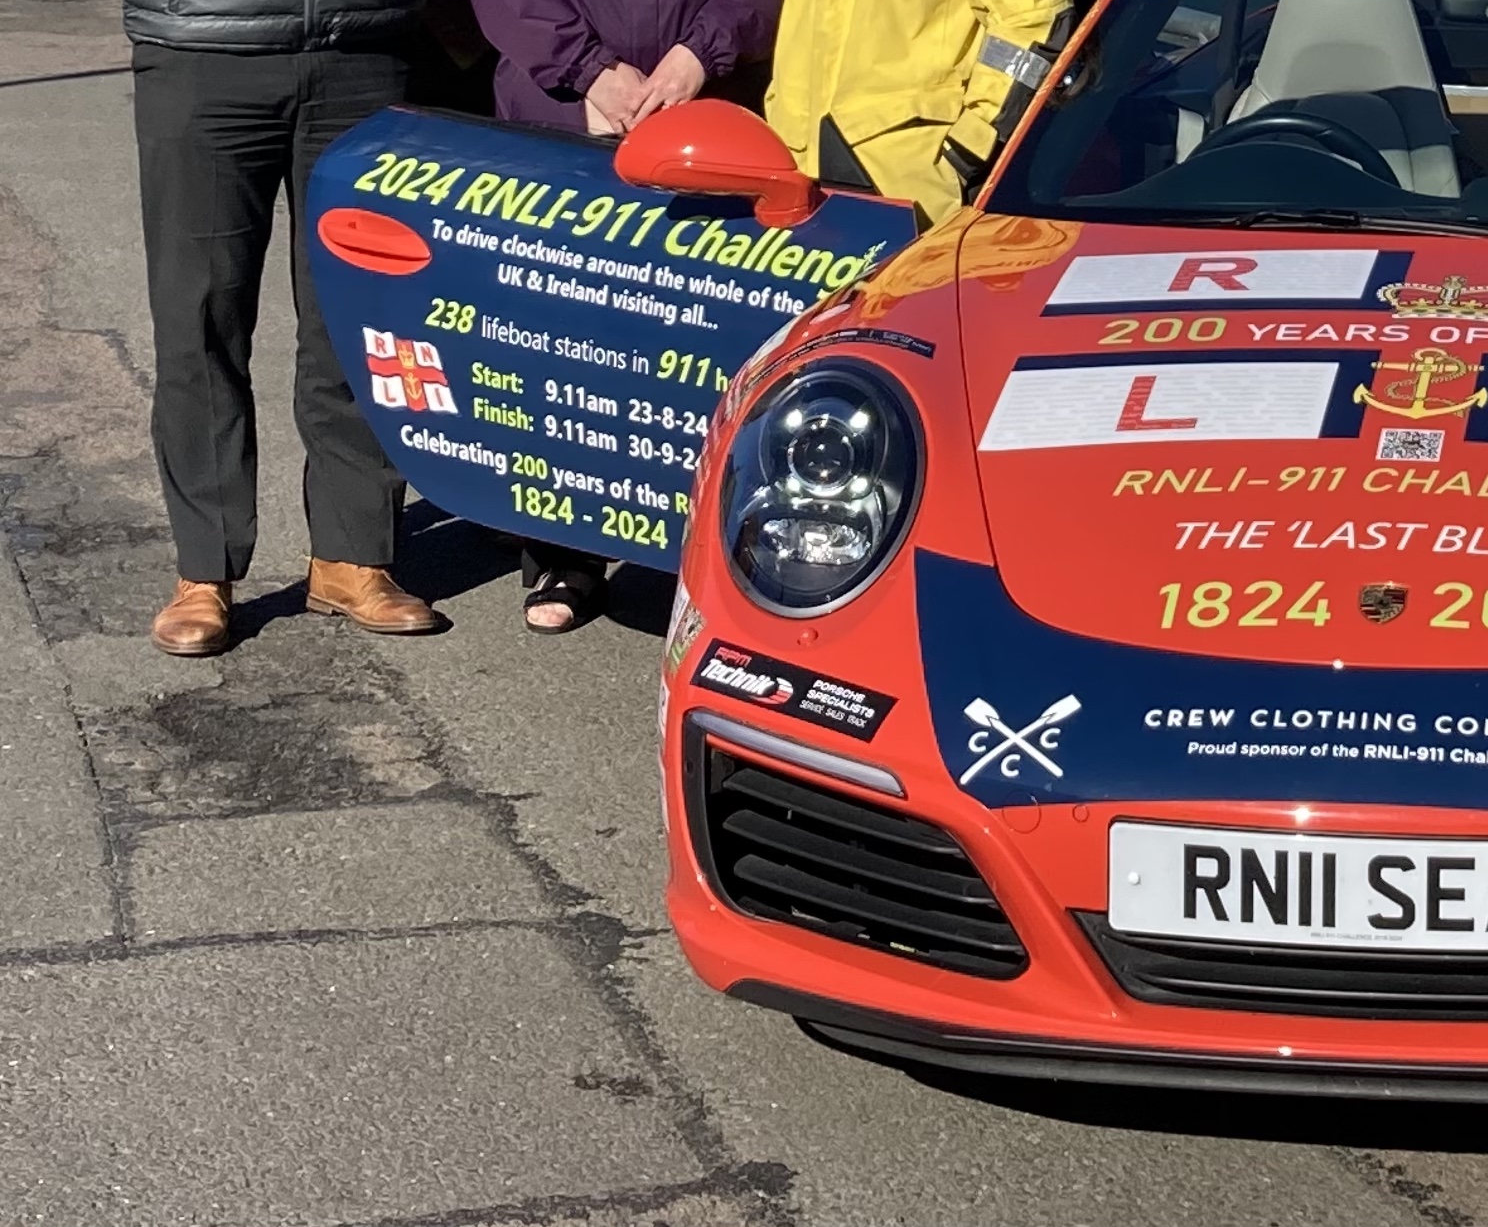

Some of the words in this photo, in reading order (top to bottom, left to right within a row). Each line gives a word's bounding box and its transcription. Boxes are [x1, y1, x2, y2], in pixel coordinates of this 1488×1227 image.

[354, 153, 466, 205] 2024
[455, 173, 667, 247] RNLI-911
[664, 215, 867, 300] Challeng
[432, 219, 452, 241] To
[456, 224, 498, 251] drive
[502, 235, 584, 269] clockwise
[586, 256, 650, 283] around
[655, 266, 685, 290] the
[689, 276, 744, 303] whole
[749, 286, 770, 306] of
[773, 290, 804, 316] the
[1168, 257, 1258, 292] R
[498, 264, 522, 287] UK
[527, 270, 542, 292] &
[546, 274, 608, 305] Ireland
[612, 288, 677, 325] visiting
[680, 305, 718, 330] all...
[425, 298, 476, 333] 238
[481, 315, 550, 352] lifeboat
[554, 339, 627, 370] stations
[633, 349, 649, 375] in
[656, 349, 711, 387] 911
[1098, 317, 1228, 345] 200
[1247, 323, 1410, 342] YEARS
[471, 362, 524, 394] Start:
[545, 379, 618, 417] 9.11am
[628, 399, 708, 437] 23-8-24
[1115, 375, 1198, 432] L
[473, 398, 534, 432] Finish:
[544, 415, 617, 452] 9.11am
[400, 425, 507, 474] Celebrating
[512, 452, 547, 480] 200
[552, 466, 604, 495] years
[609, 478, 632, 501] of
[636, 483, 670, 511] the
[1112, 466, 1347, 497] RNLI-911
[511, 483, 574, 525] 1824
[601, 506, 668, 549] 2024
[1175, 521, 1275, 550] THE
[1287, 520, 1428, 551] 'LAST
[1159, 580, 1331, 630] 1824
[701, 658, 776, 695] Technik
[812, 679, 867, 703] PORSCHE
[806, 689, 875, 718] SPECIALISTS
[1144, 708, 1235, 728] CREW
[1250, 708, 1417, 732] CLOTHING
[968, 731, 989, 753] C
[1039, 728, 1061, 749] C
[1187, 741, 1236, 756] Proud
[1240, 742, 1306, 759] sponsor
[1310, 743, 1328, 757] of
[1332, 744, 1359, 759] the
[1364, 743, 1444, 762] RNLI-911
[1000, 754, 1021, 777] C
[1182, 844, 1337, 929] RN11
